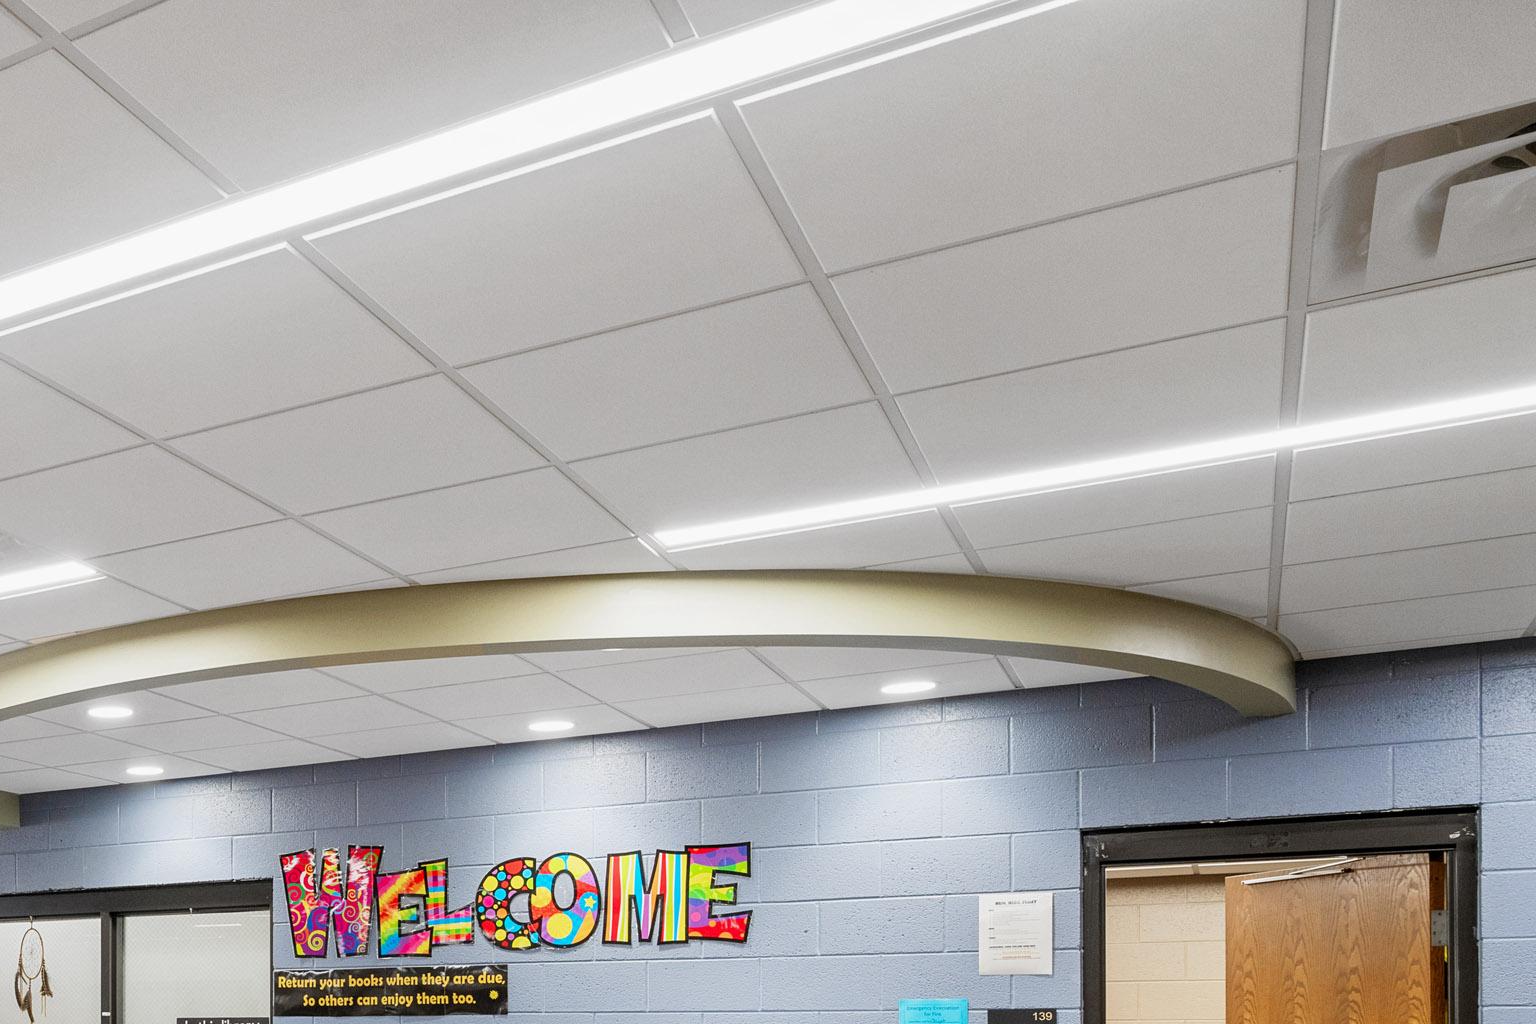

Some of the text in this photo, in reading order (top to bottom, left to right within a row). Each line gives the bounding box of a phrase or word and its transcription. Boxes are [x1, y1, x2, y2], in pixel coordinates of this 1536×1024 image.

[279, 841, 754, 958] WELCOME
[278, 971, 506, 990] Return your books when they are due,
[303, 992, 476, 1009] So others can enjoy them too.
[1032, 1012, 1053, 1020] 139
